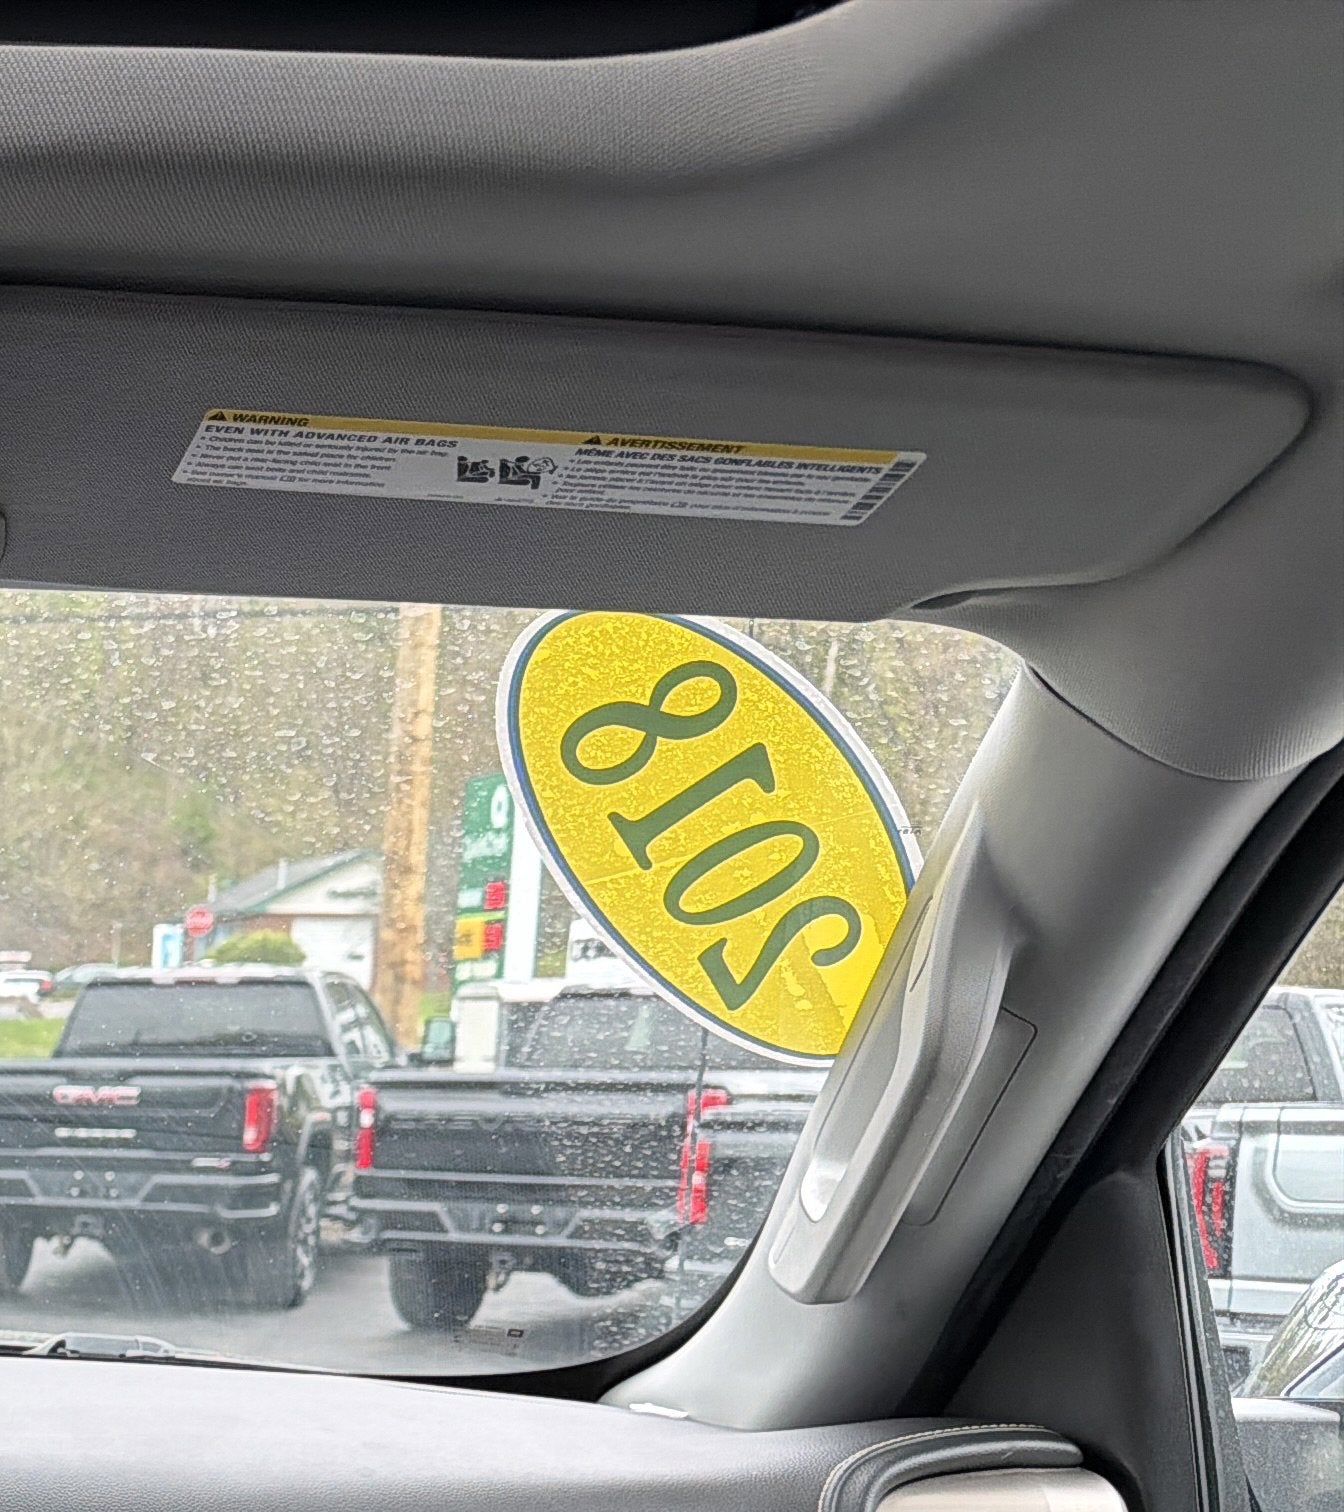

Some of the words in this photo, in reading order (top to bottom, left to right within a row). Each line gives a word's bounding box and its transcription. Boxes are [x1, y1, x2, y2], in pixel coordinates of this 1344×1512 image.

[233, 413, 309, 427] WARNING
[204, 425, 245, 435] EVEN
[250, 427, 288, 437] WITH
[294, 430, 377, 442] ADVANCED
[383, 436, 408, 446] AIR
[415, 438, 459, 449] BAGS
[606, 437, 746, 454] AVERTISSEMENT
[615, 450, 648, 460] AVEC
[650, 453, 677, 462] DES
[677, 454, 711, 464] SACS
[714, 457, 795, 470] GONFLABLES
[795, 463, 883, 475] INTELLIGENTS
